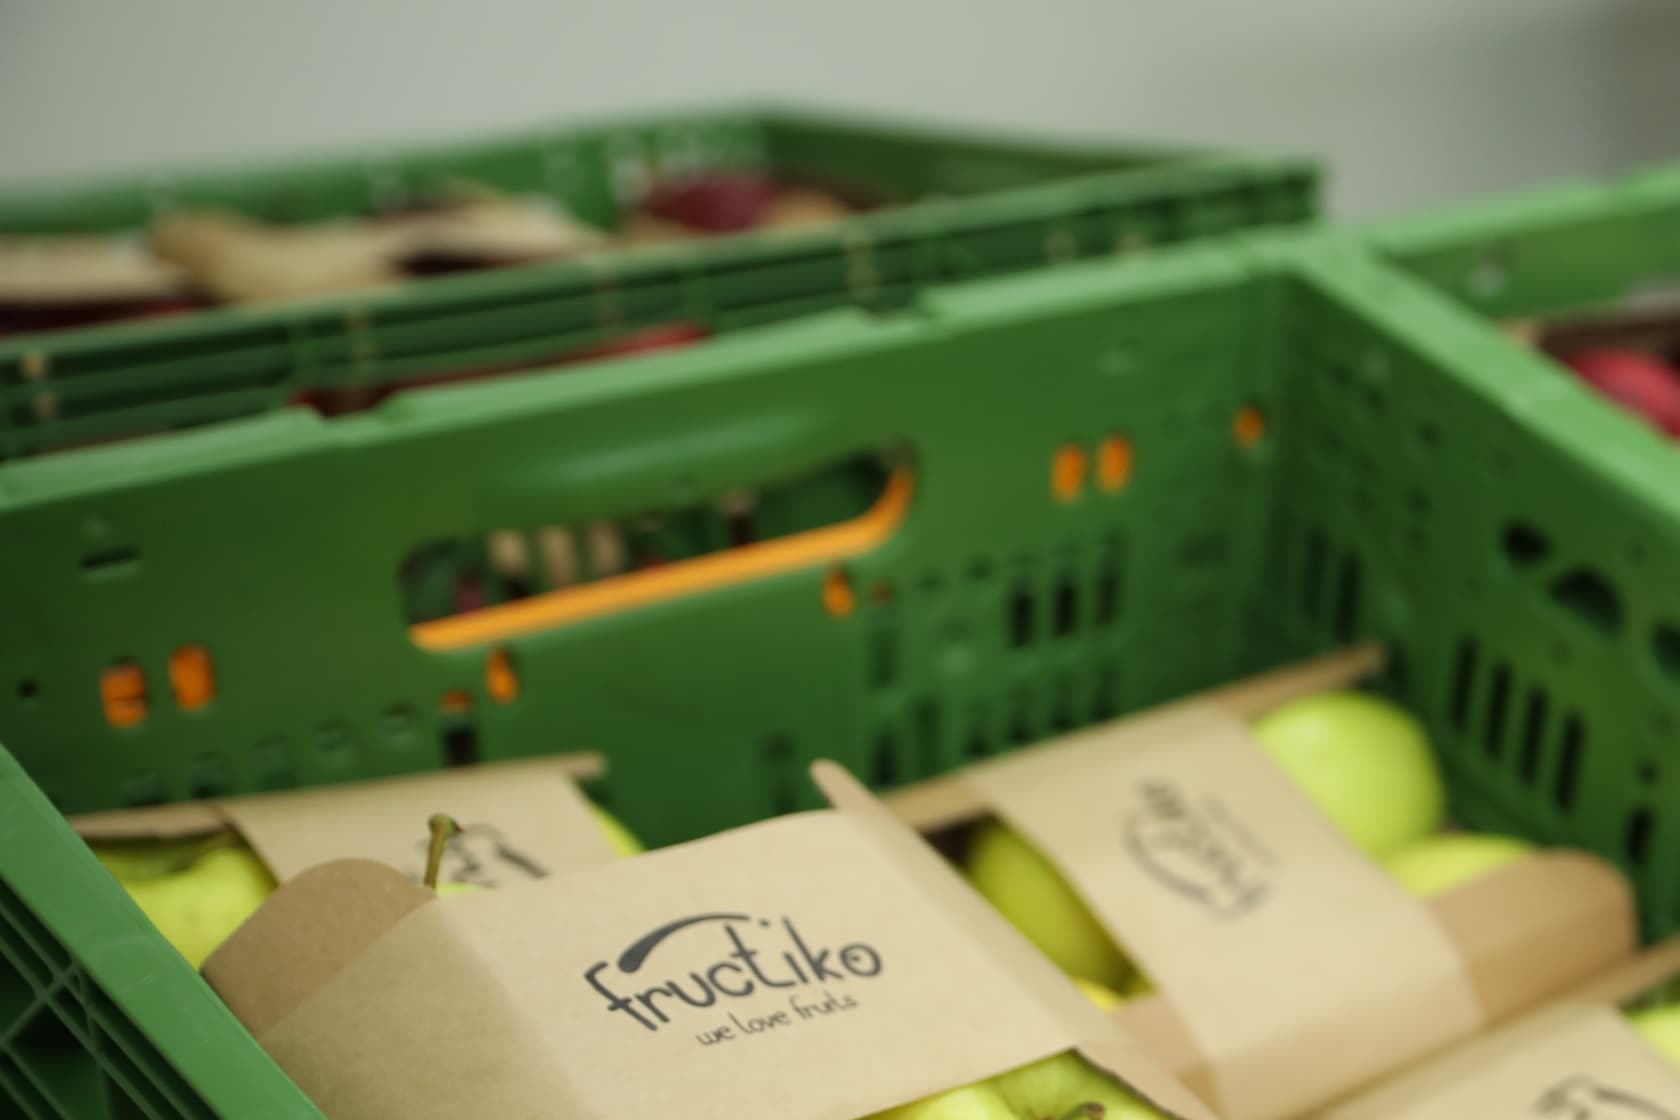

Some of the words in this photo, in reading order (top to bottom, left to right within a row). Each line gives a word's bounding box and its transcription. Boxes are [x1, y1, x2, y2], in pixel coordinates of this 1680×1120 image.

[584, 913, 882, 1031] fructiko
[696, 1025, 735, 1046] we
[728, 1012, 792, 1035] love
[789, 990, 859, 1019] fruits
